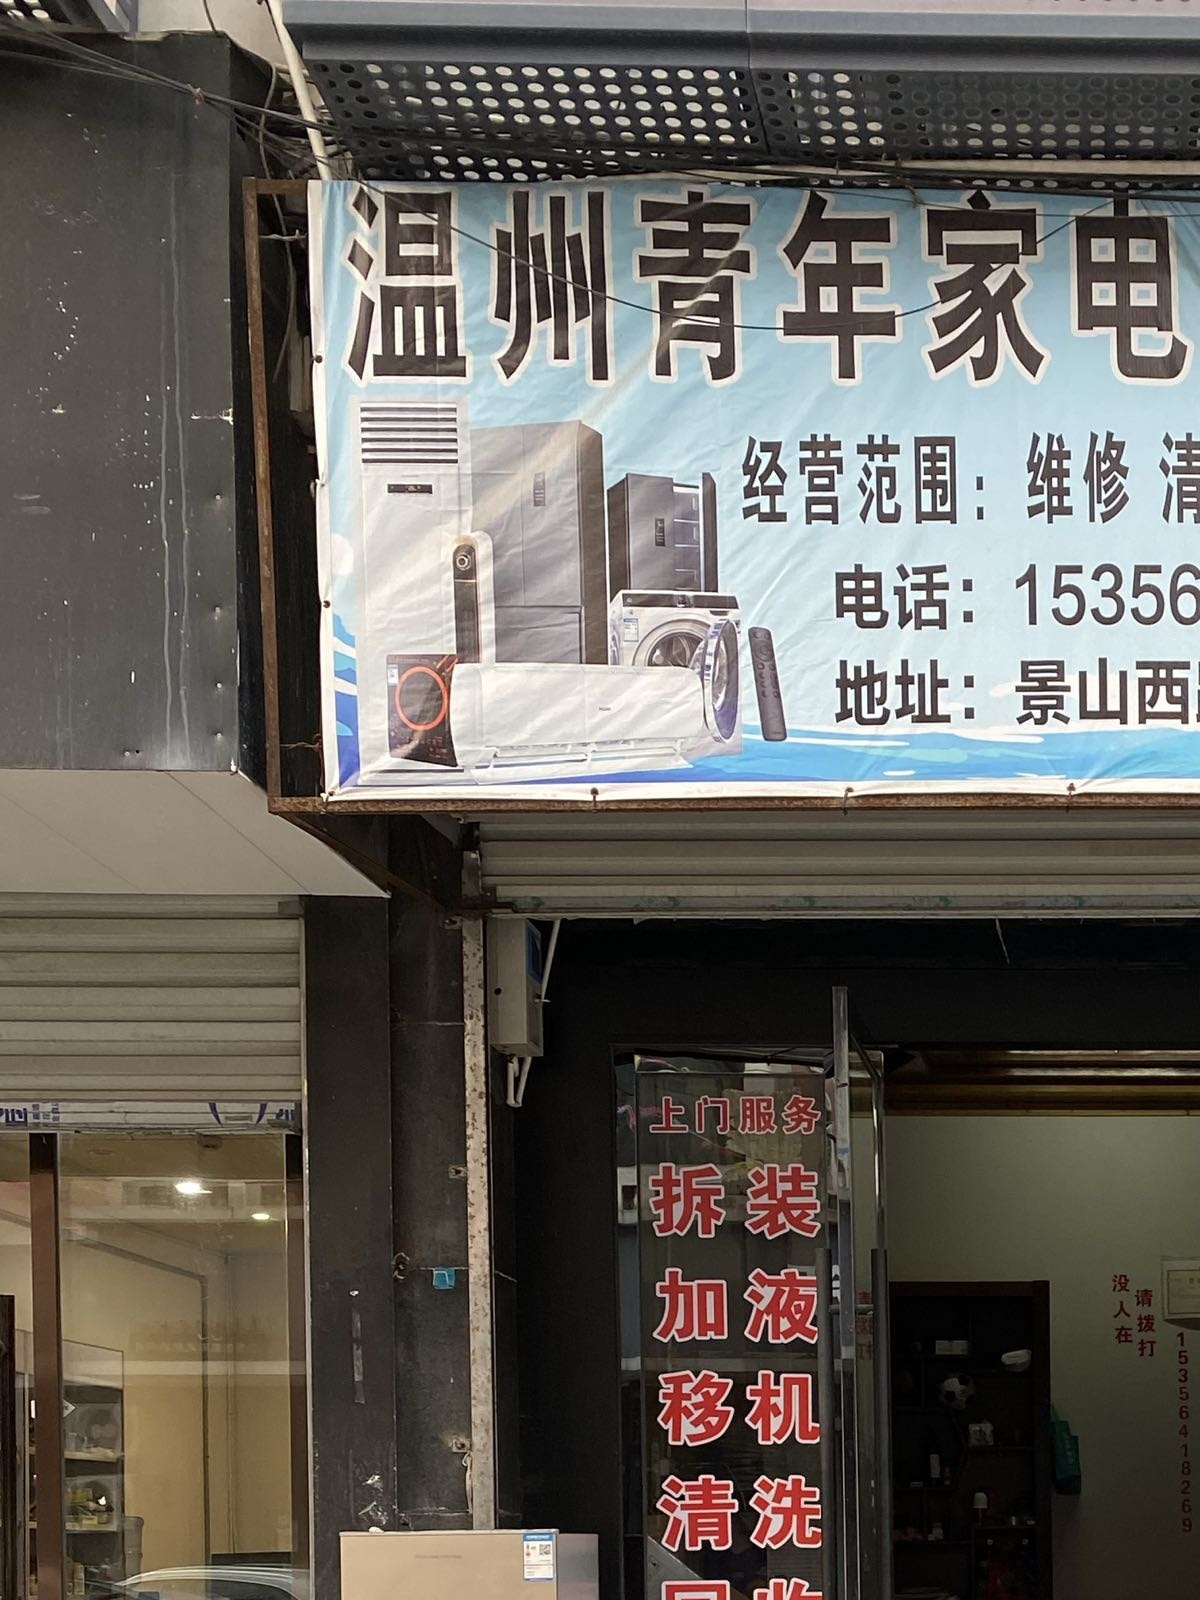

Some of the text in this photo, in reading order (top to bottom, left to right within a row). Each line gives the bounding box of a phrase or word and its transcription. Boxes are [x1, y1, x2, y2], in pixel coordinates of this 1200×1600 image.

[649, 1096, 822, 1136] 上门服务
[648, 1162, 822, 1239] 拆装
[652, 1267, 819, 1344] 加液
[1112, 1274, 1134, 1344] 没人在
[1135, 1289, 1157, 1357] 请拨打
[658, 1370, 821, 1448] 移机
[1176, 1332, 1193, 1533] 15356418269
[657, 1474, 823, 1551] 清洗
